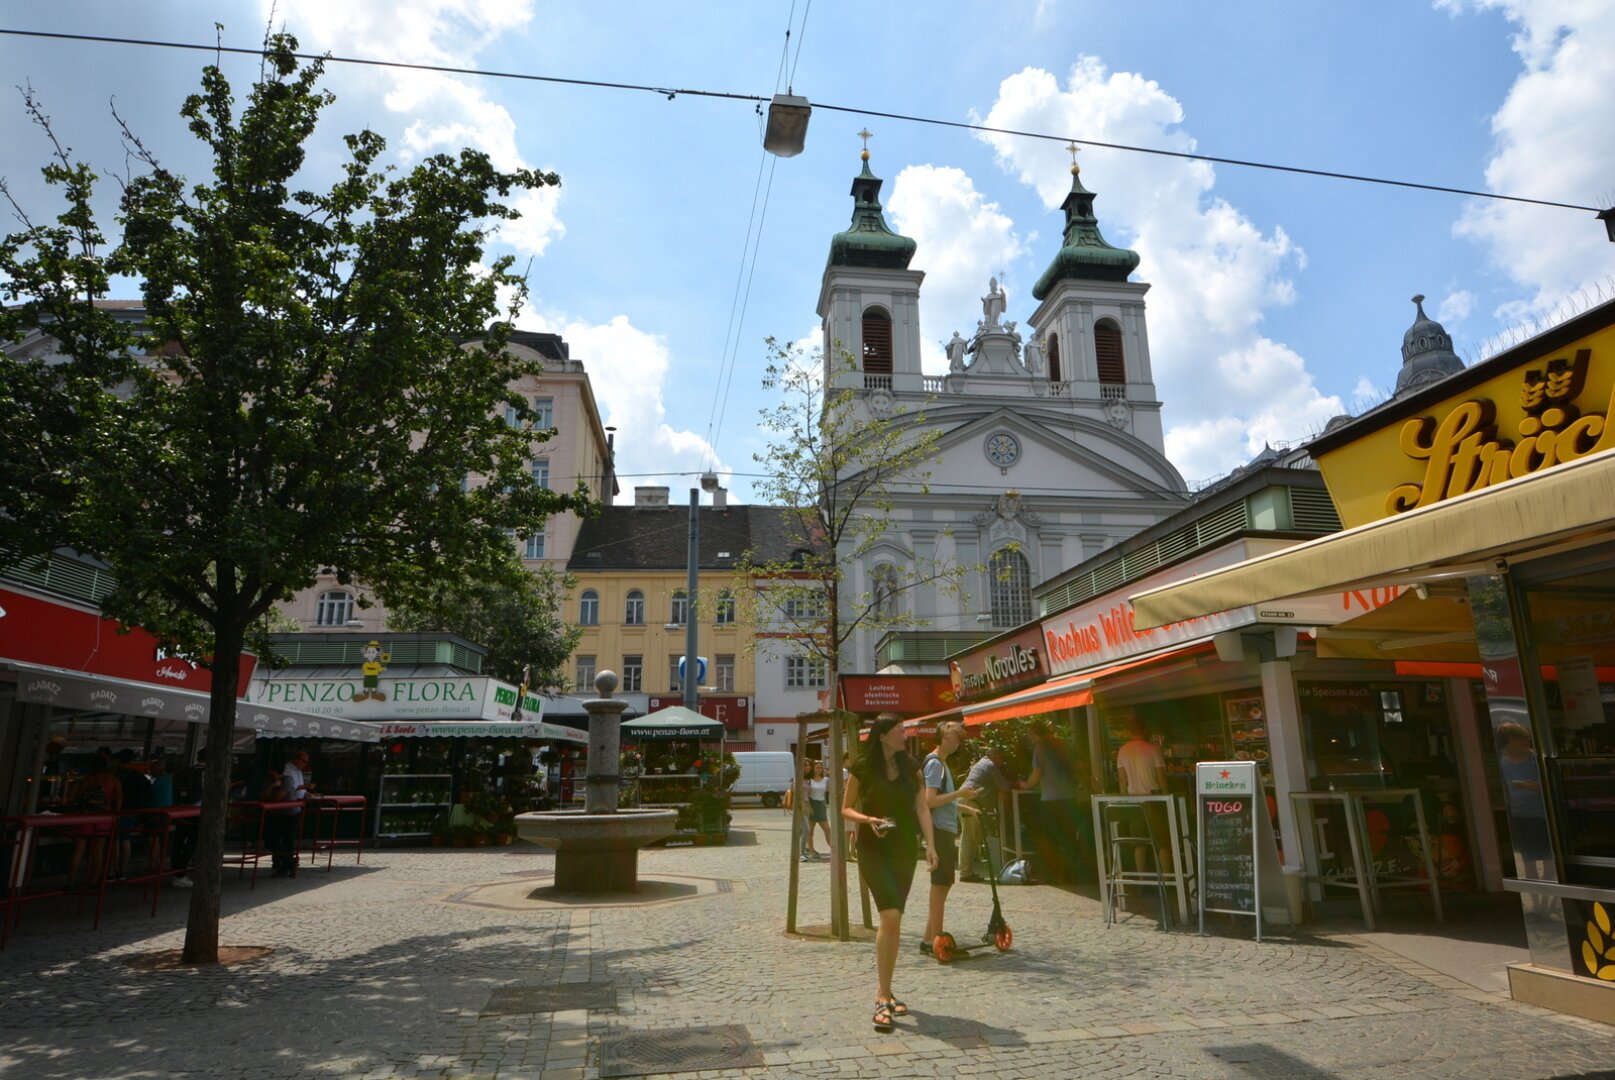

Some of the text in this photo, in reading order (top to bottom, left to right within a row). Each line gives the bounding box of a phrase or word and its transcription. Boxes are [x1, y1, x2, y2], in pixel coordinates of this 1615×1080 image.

[1046, 621, 1101, 664] Rochus
[984, 644, 1036, 683] Noodles
[27, 680, 62, 696] RADATZ
[267, 682, 476, 703] PENZO FLORA
[90, 689, 118, 704] RADATZ
[141, 696, 165, 710] RADATZ
[494, 686, 516, 707] PENZO
[522, 695, 541, 714] FLORA
[395, 706, 471, 715] www.penzo-flora.at
[431, 725, 524, 736] www.penzo-flora.at
[631, 728, 710, 738] www.penzo-flora.at
[1205, 781, 1246, 790] Heineken
